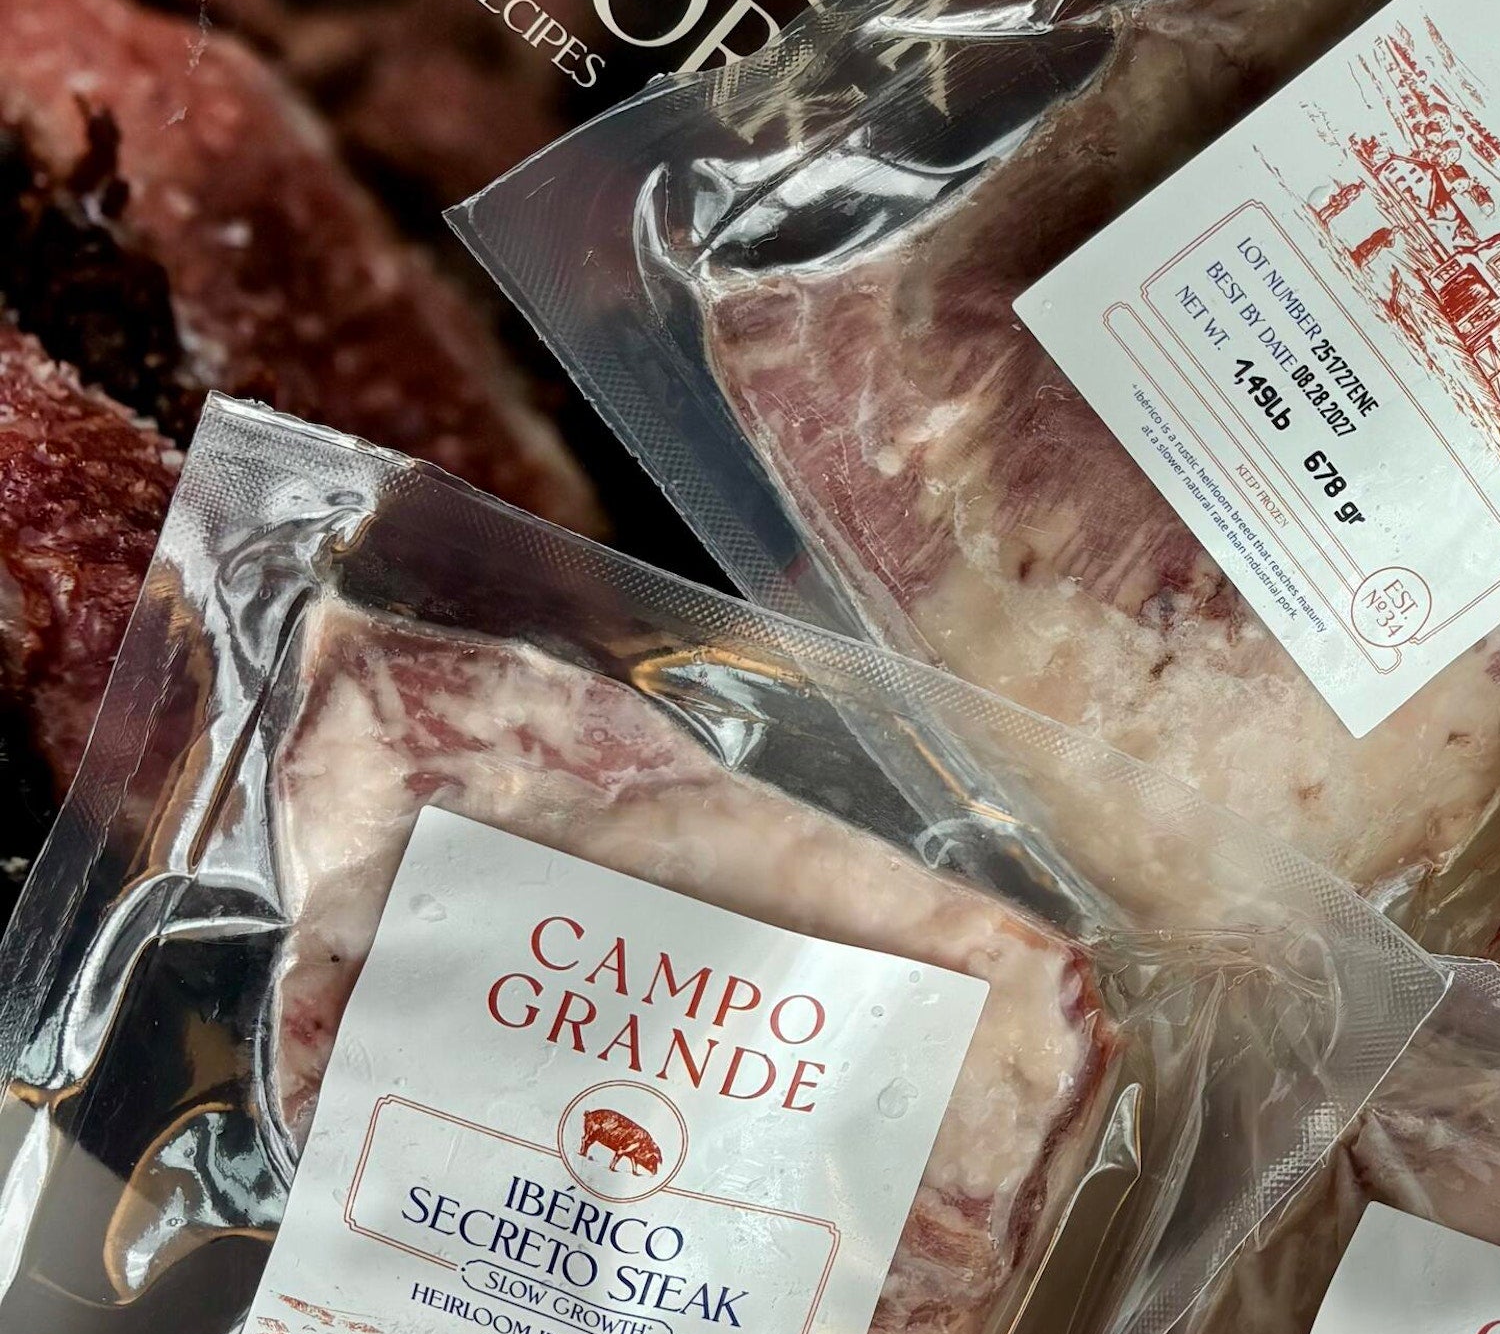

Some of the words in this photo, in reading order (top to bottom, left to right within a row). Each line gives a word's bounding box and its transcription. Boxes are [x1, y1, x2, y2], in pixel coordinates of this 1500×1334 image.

[1205, 260, 1247, 304] BEST
[1238, 302, 1266, 327] BY
[1257, 326, 1298, 372] DATE
[1290, 364, 1356, 437] 08.28.2027
[1236, 236, 1270, 271] LOT
[1262, 269, 1322, 341] NUMBER
[1310, 338, 1379, 418] 251727ENE
[1174, 285, 1209, 320] NET
[1203, 317, 1230, 351] WT.
[1303, 450, 1347, 498] 678
[1333, 501, 1365, 525] gr
[1140, 425, 1153, 437] at
[1149, 436, 1159, 445] a
[1155, 443, 1186, 475] slower
[1181, 476, 1215, 512] natural
[1209, 510, 1229, 532] rate
[1225, 530, 1246, 555] than
[1243, 552, 1282, 597] industrial
[1274, 595, 1297, 621] pork.
[1234, 463, 1260, 490] KEEP
[1255, 489, 1289, 528] FROZEN
[1382, 578, 1418, 620] EST.
[487, 972, 825, 1112] GRANDE
[530, 916, 825, 1045] CAMPO
[401, 1186, 598, 1287] SECRETO
[607, 1265, 749, 1328] STEAK
[504, 1175, 684, 1262] IBÉRICO
